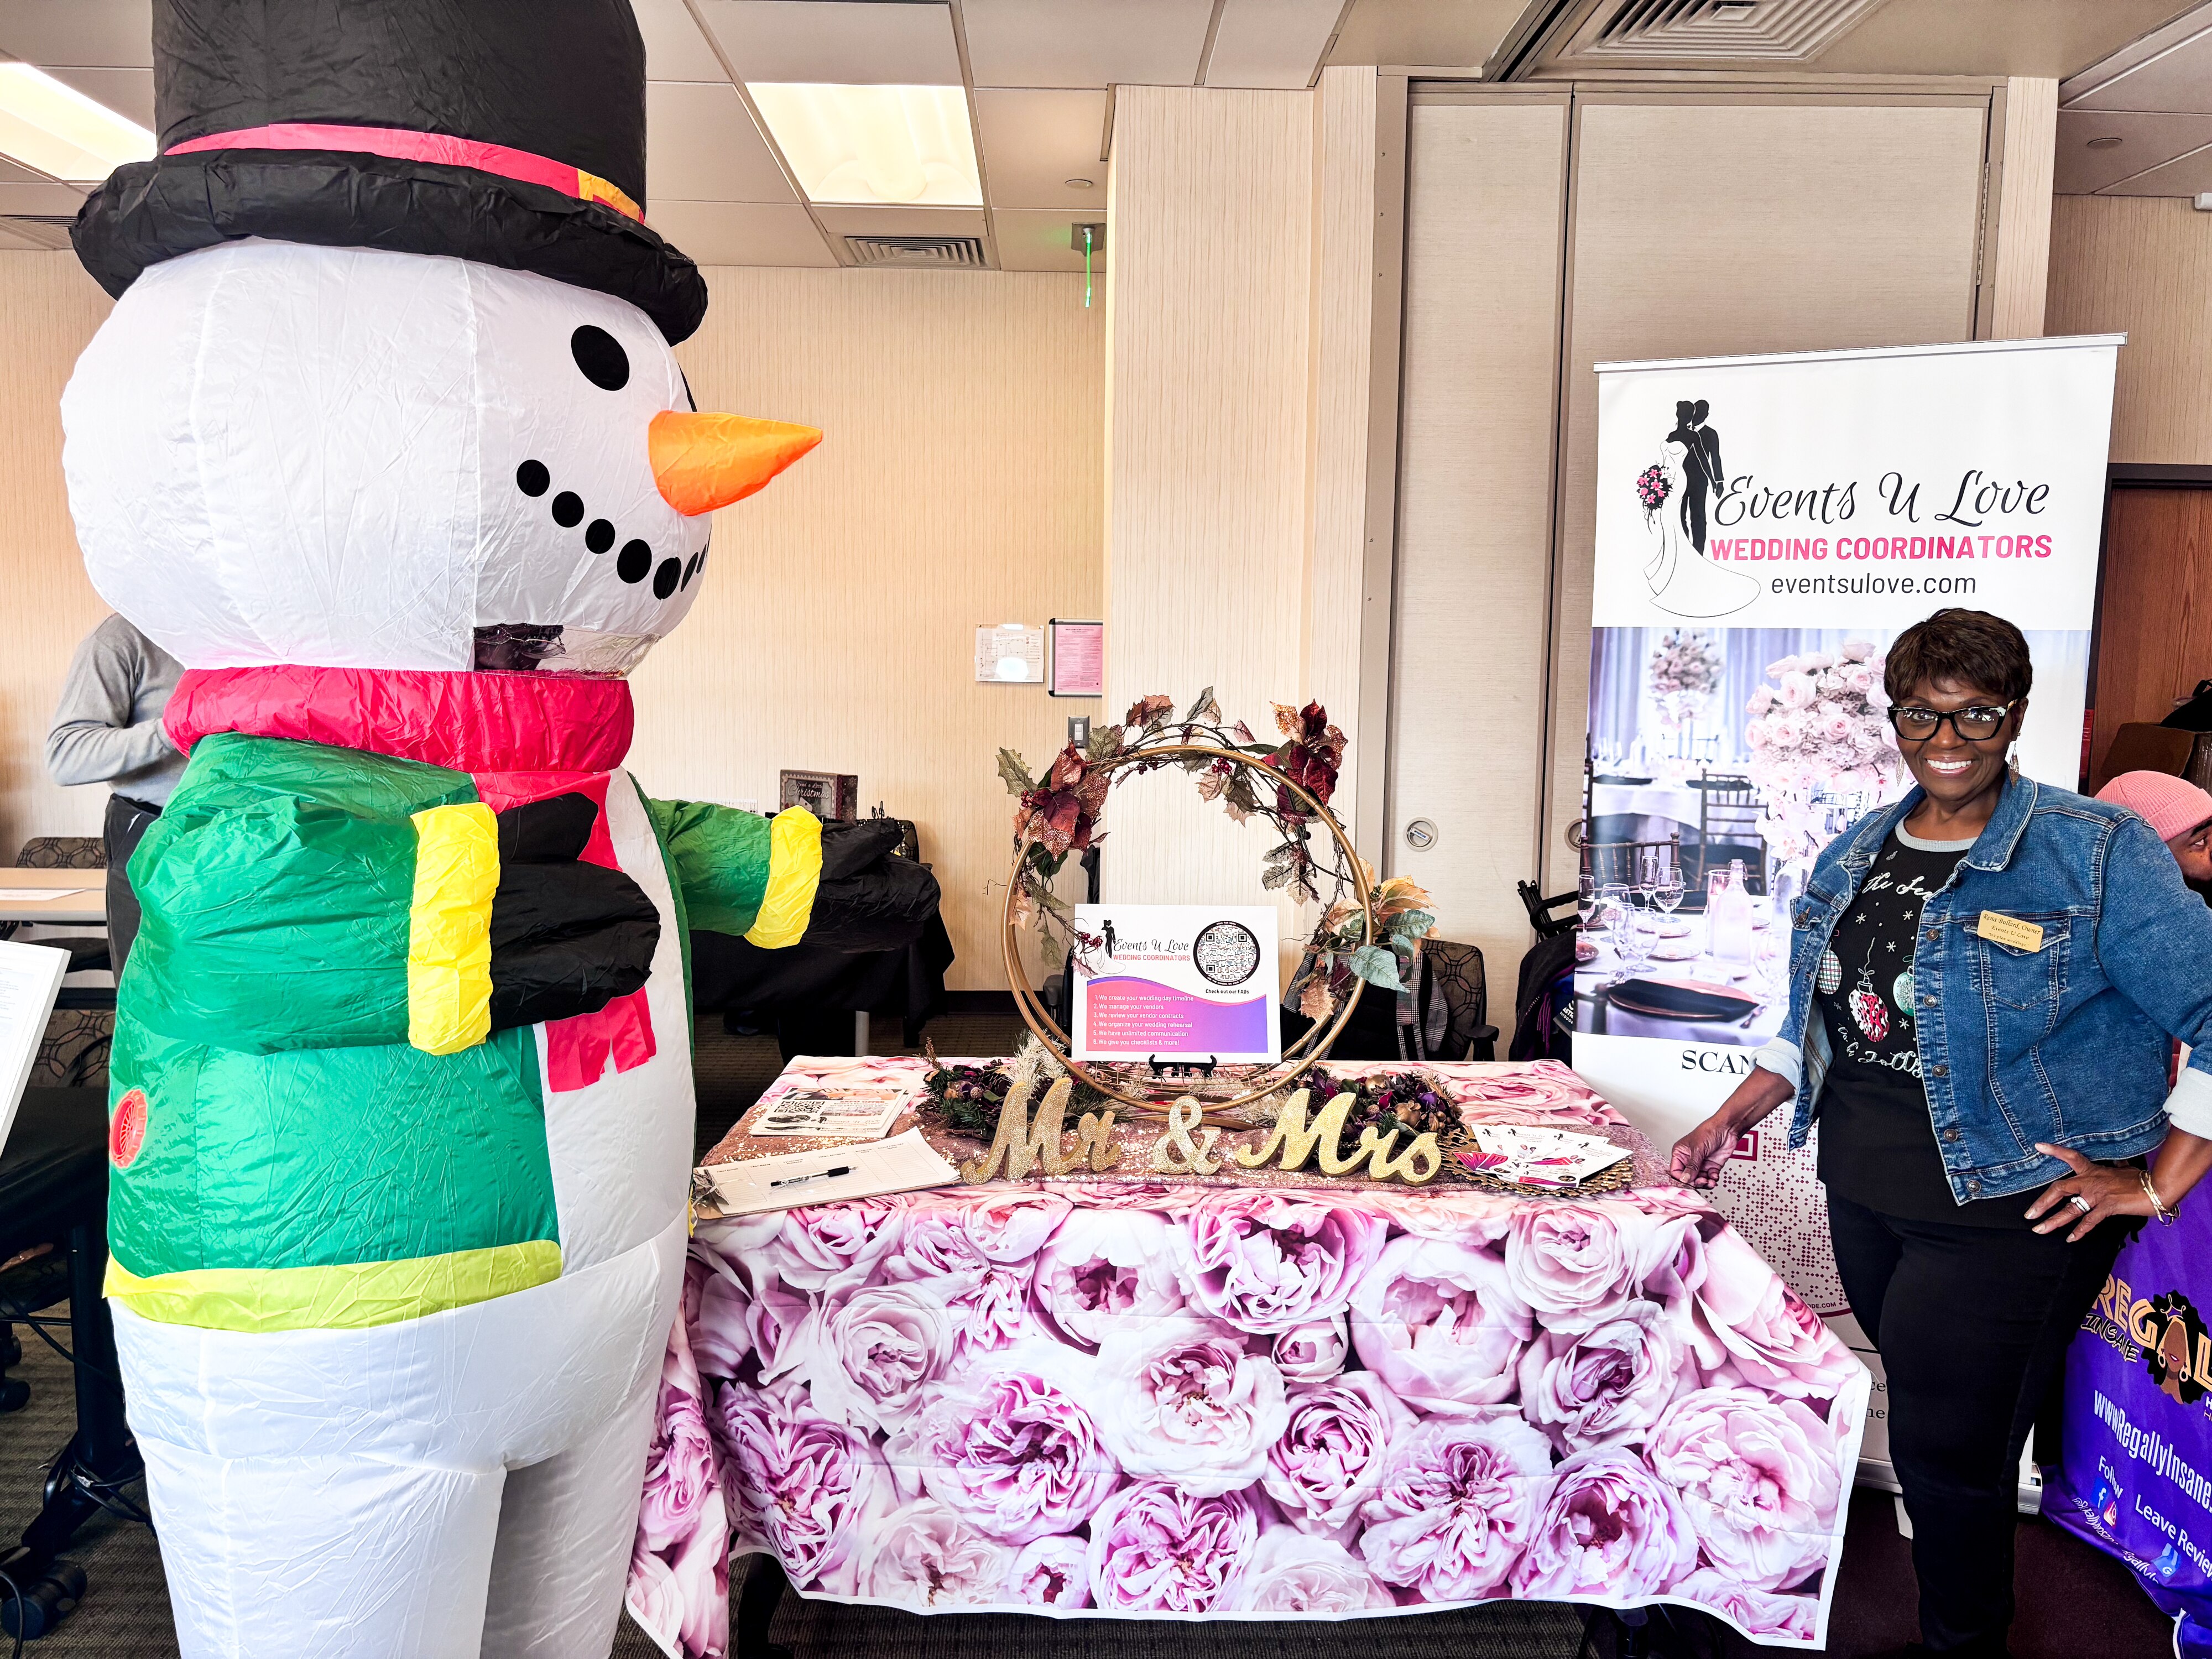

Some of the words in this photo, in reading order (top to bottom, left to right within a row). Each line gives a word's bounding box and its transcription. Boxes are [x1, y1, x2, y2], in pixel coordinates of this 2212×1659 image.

[1715, 475, 1857, 526] Events
[1879, 472, 1920, 523] U
[1934, 469, 2049, 527] Love
[1710, 538, 1828, 560] WEDDING
[1837, 535, 2052, 560] COORDINATORS
[1772, 572, 1976, 593] eventsulove.com
[787, 784, 830, 800] Christmas
[2022, 925, 2041, 935] Owner
[1113, 938, 1147, 951] Events
[1151, 939, 1161, 952] U
[1164, 940, 1189, 953] Love
[961, 1077, 1121, 1186] Mr
[1152, 1095, 1222, 1176] &
[1236, 1088, 1442, 1187] Mrs
[2080, 1313, 2140, 1363] INSANE
[2135, 1494, 2176, 1540] Leave
